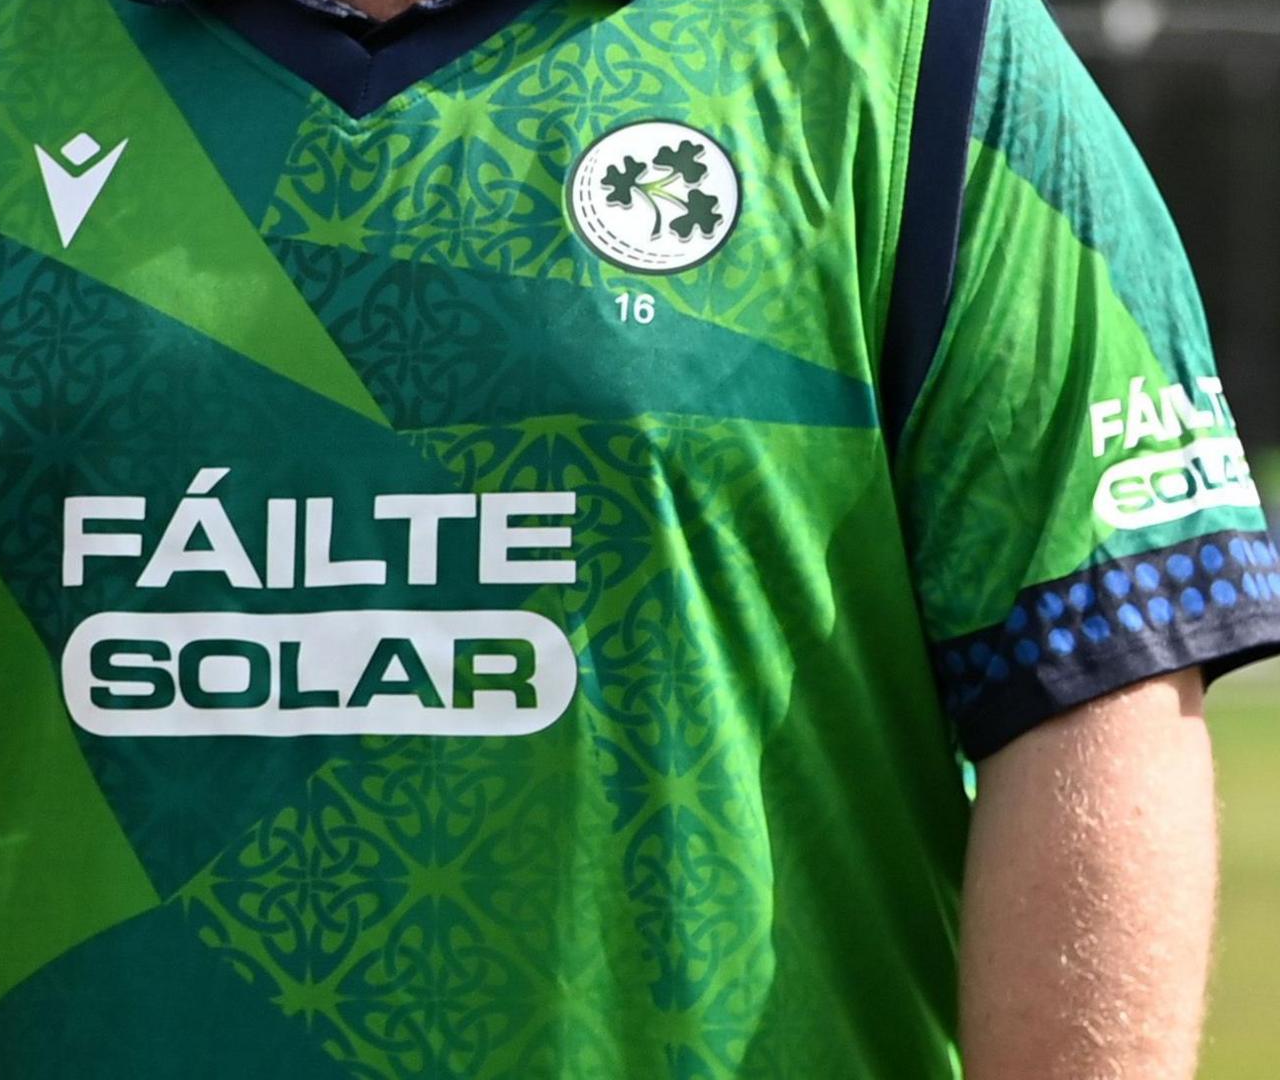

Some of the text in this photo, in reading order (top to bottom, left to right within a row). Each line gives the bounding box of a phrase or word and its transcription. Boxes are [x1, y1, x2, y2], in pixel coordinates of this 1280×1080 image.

[614, 291, 656, 324] 16
[1090, 376, 1236, 457] FÁILT
[62, 467, 577, 588] FÁILTE
[90, 638, 538, 710] SOLAR
